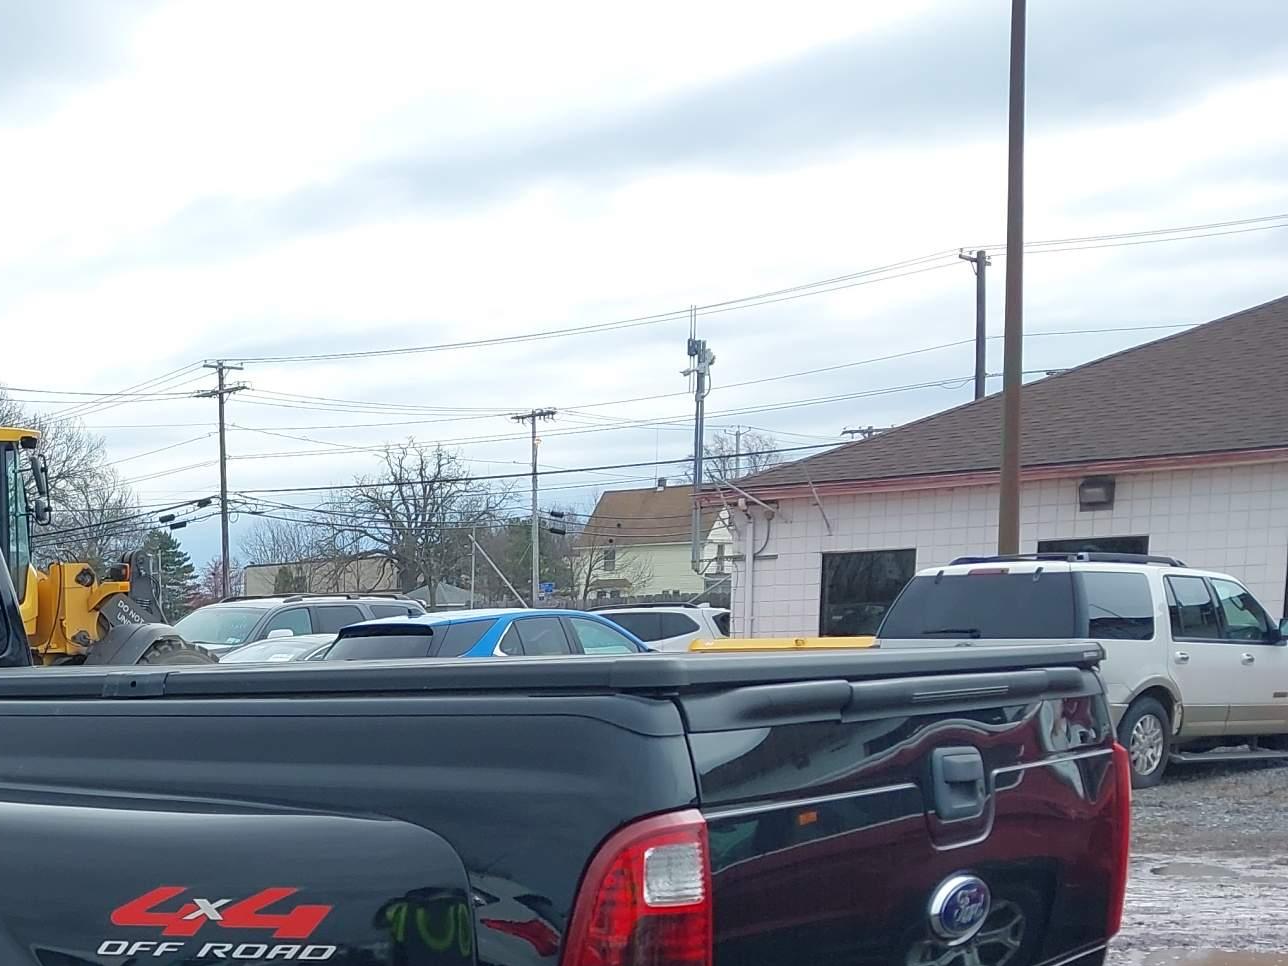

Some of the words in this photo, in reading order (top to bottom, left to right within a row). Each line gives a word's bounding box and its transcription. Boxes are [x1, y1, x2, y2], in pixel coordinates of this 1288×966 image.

[117, 600, 129, 612] DO
[129, 610, 144, 624] NOT
[96, 939, 186, 957] OFF
[195, 942, 338, 961] ROAD
